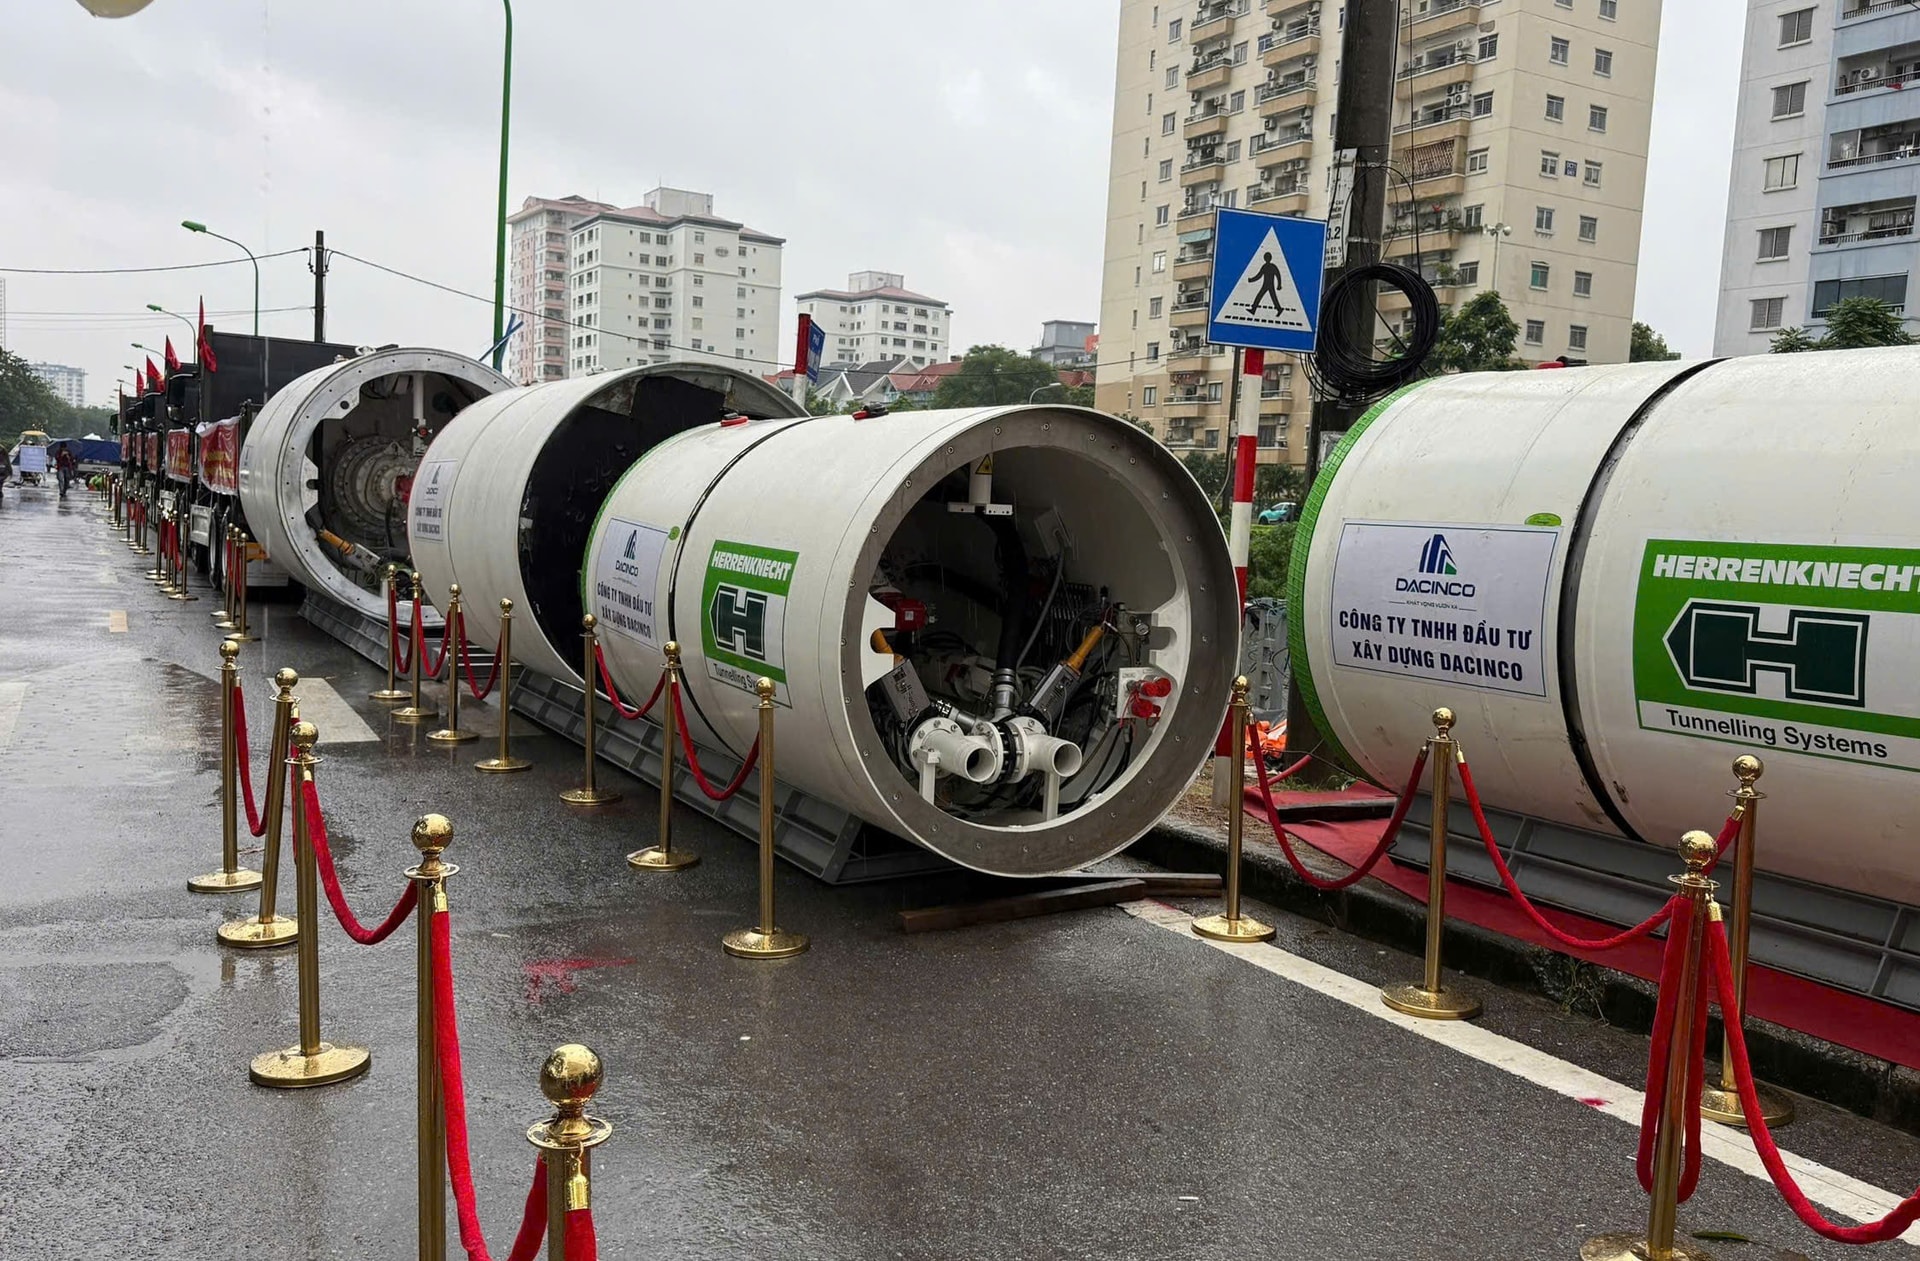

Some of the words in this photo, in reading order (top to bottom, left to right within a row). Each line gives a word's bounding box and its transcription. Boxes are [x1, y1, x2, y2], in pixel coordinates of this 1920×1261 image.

[711, 551, 792, 582] HERRENKNECHT
[1395, 578, 1476, 598] DACINCO
[1339, 609, 1382, 633] CÔNG
[1387, 616, 1406, 636] TY
[1411, 619, 1457, 642] TNHH
[1463, 619, 1500, 647] ĐẦU
[1507, 630, 1532, 650] TƯ
[713, 663, 748, 689] Tunnelling
[1352, 639, 1382, 661] XÂY
[1388, 646, 1435, 670] DỰNG
[1440, 655, 1523, 682] DACINCO
[1666, 709, 1777, 746] Tunnelling
[1783, 727, 1888, 759] Systems
